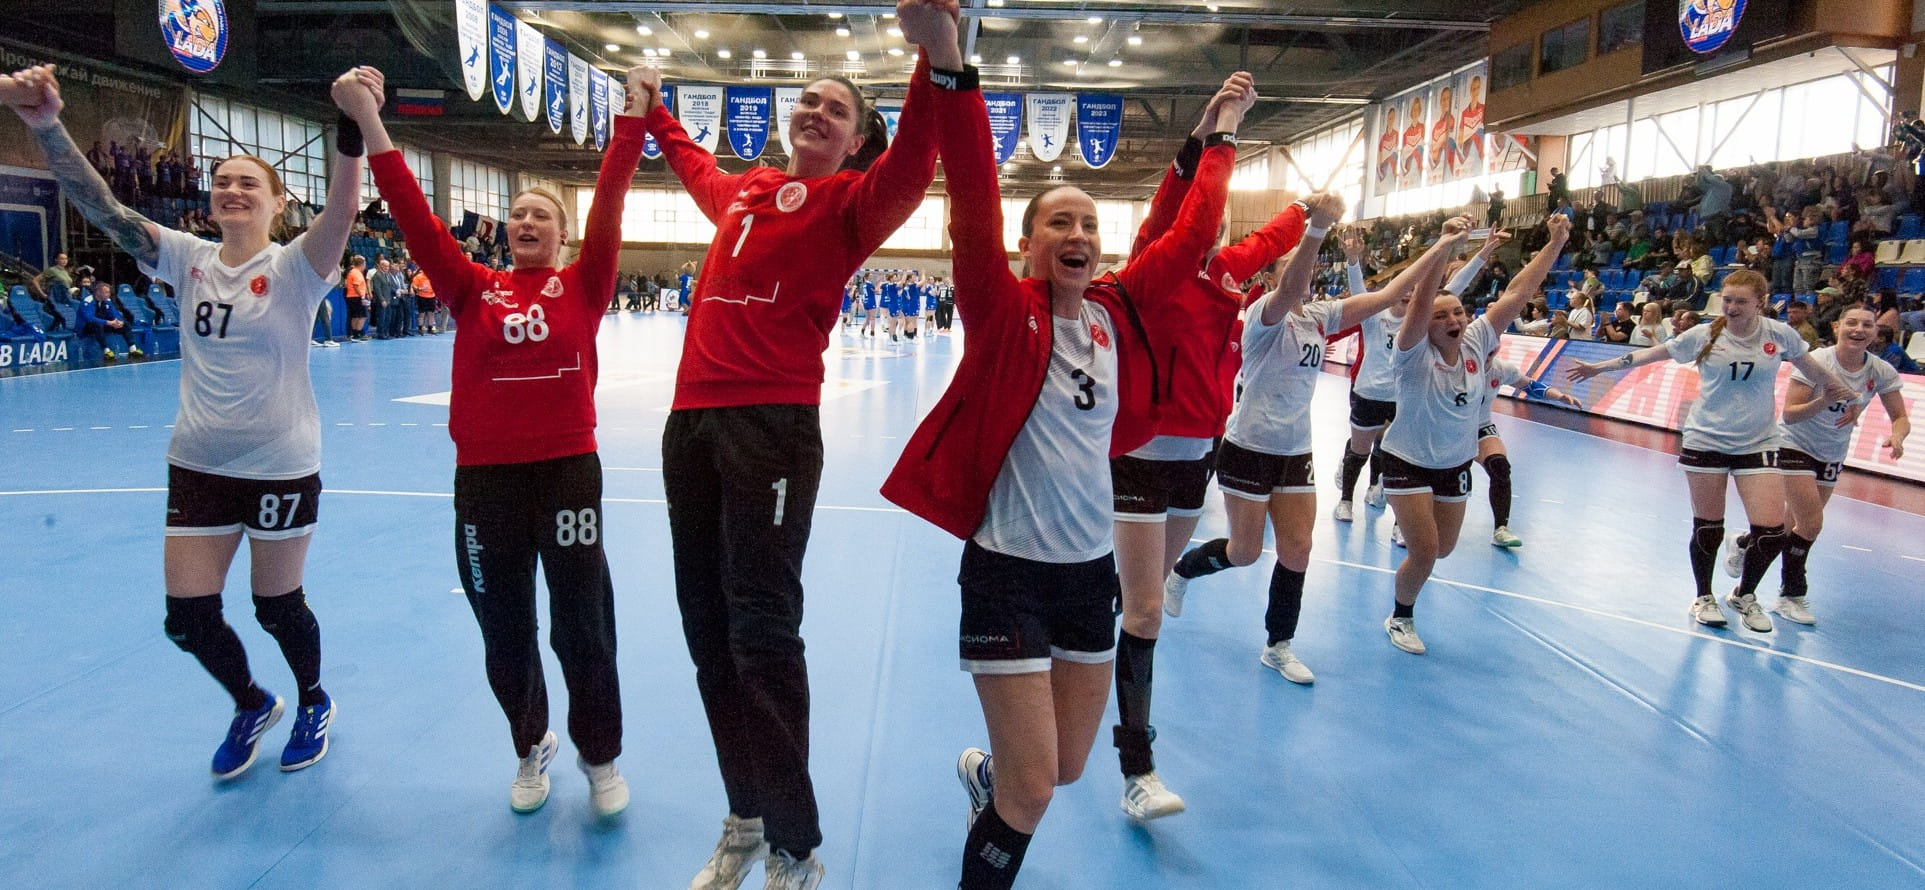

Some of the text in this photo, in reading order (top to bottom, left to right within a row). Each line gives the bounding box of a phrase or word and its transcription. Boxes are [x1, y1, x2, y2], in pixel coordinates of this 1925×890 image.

[1690, 9, 1733, 39] LADA
[173, 30, 217, 63] LADA
[91, 73, 161, 98] движение
[732, 214, 754, 257] 1
[194, 301, 234, 339] 87
[503, 303, 549, 344] 88
[19, 341, 68, 365] LADA
[1299, 343, 1321, 368] 20
[1729, 361, 1755, 381] 17
[1071, 369, 1096, 411] 3
[1458, 470, 1468, 494] 8
[258, 493, 302, 528] 87
[772, 478, 787, 526] 1
[556, 508, 598, 547] 88
[464, 523, 486, 593] Kempa
